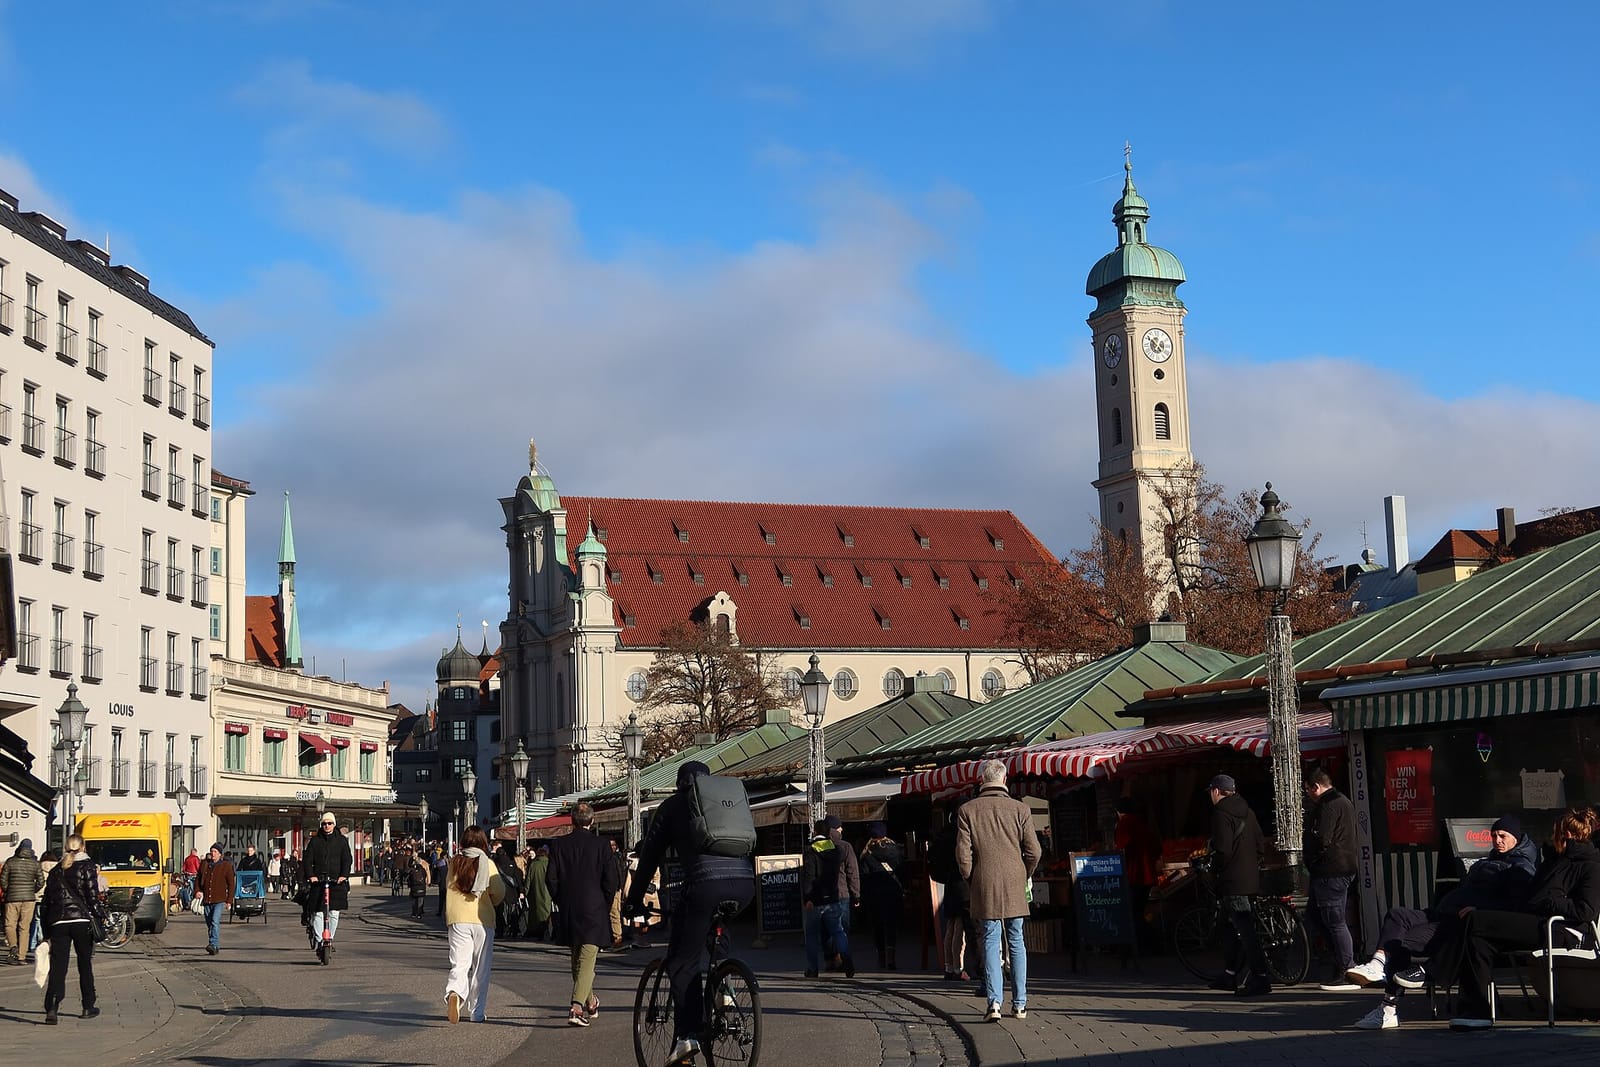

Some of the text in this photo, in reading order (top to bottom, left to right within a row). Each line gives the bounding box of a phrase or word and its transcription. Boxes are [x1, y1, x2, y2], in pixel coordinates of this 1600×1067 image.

[109, 702, 134, 717] LOUIS
[1397, 766, 1416, 777] WIN
[1390, 778, 1408, 788] TER
[1397, 789, 1417, 800] ZAU
[1390, 800, 1409, 811] BER
[0, 810, 30, 819] UIS
[220, 823, 262, 850] GERRY
[1361, 846, 1372, 889] Eis
[761, 872, 799, 885] SANDWICH
